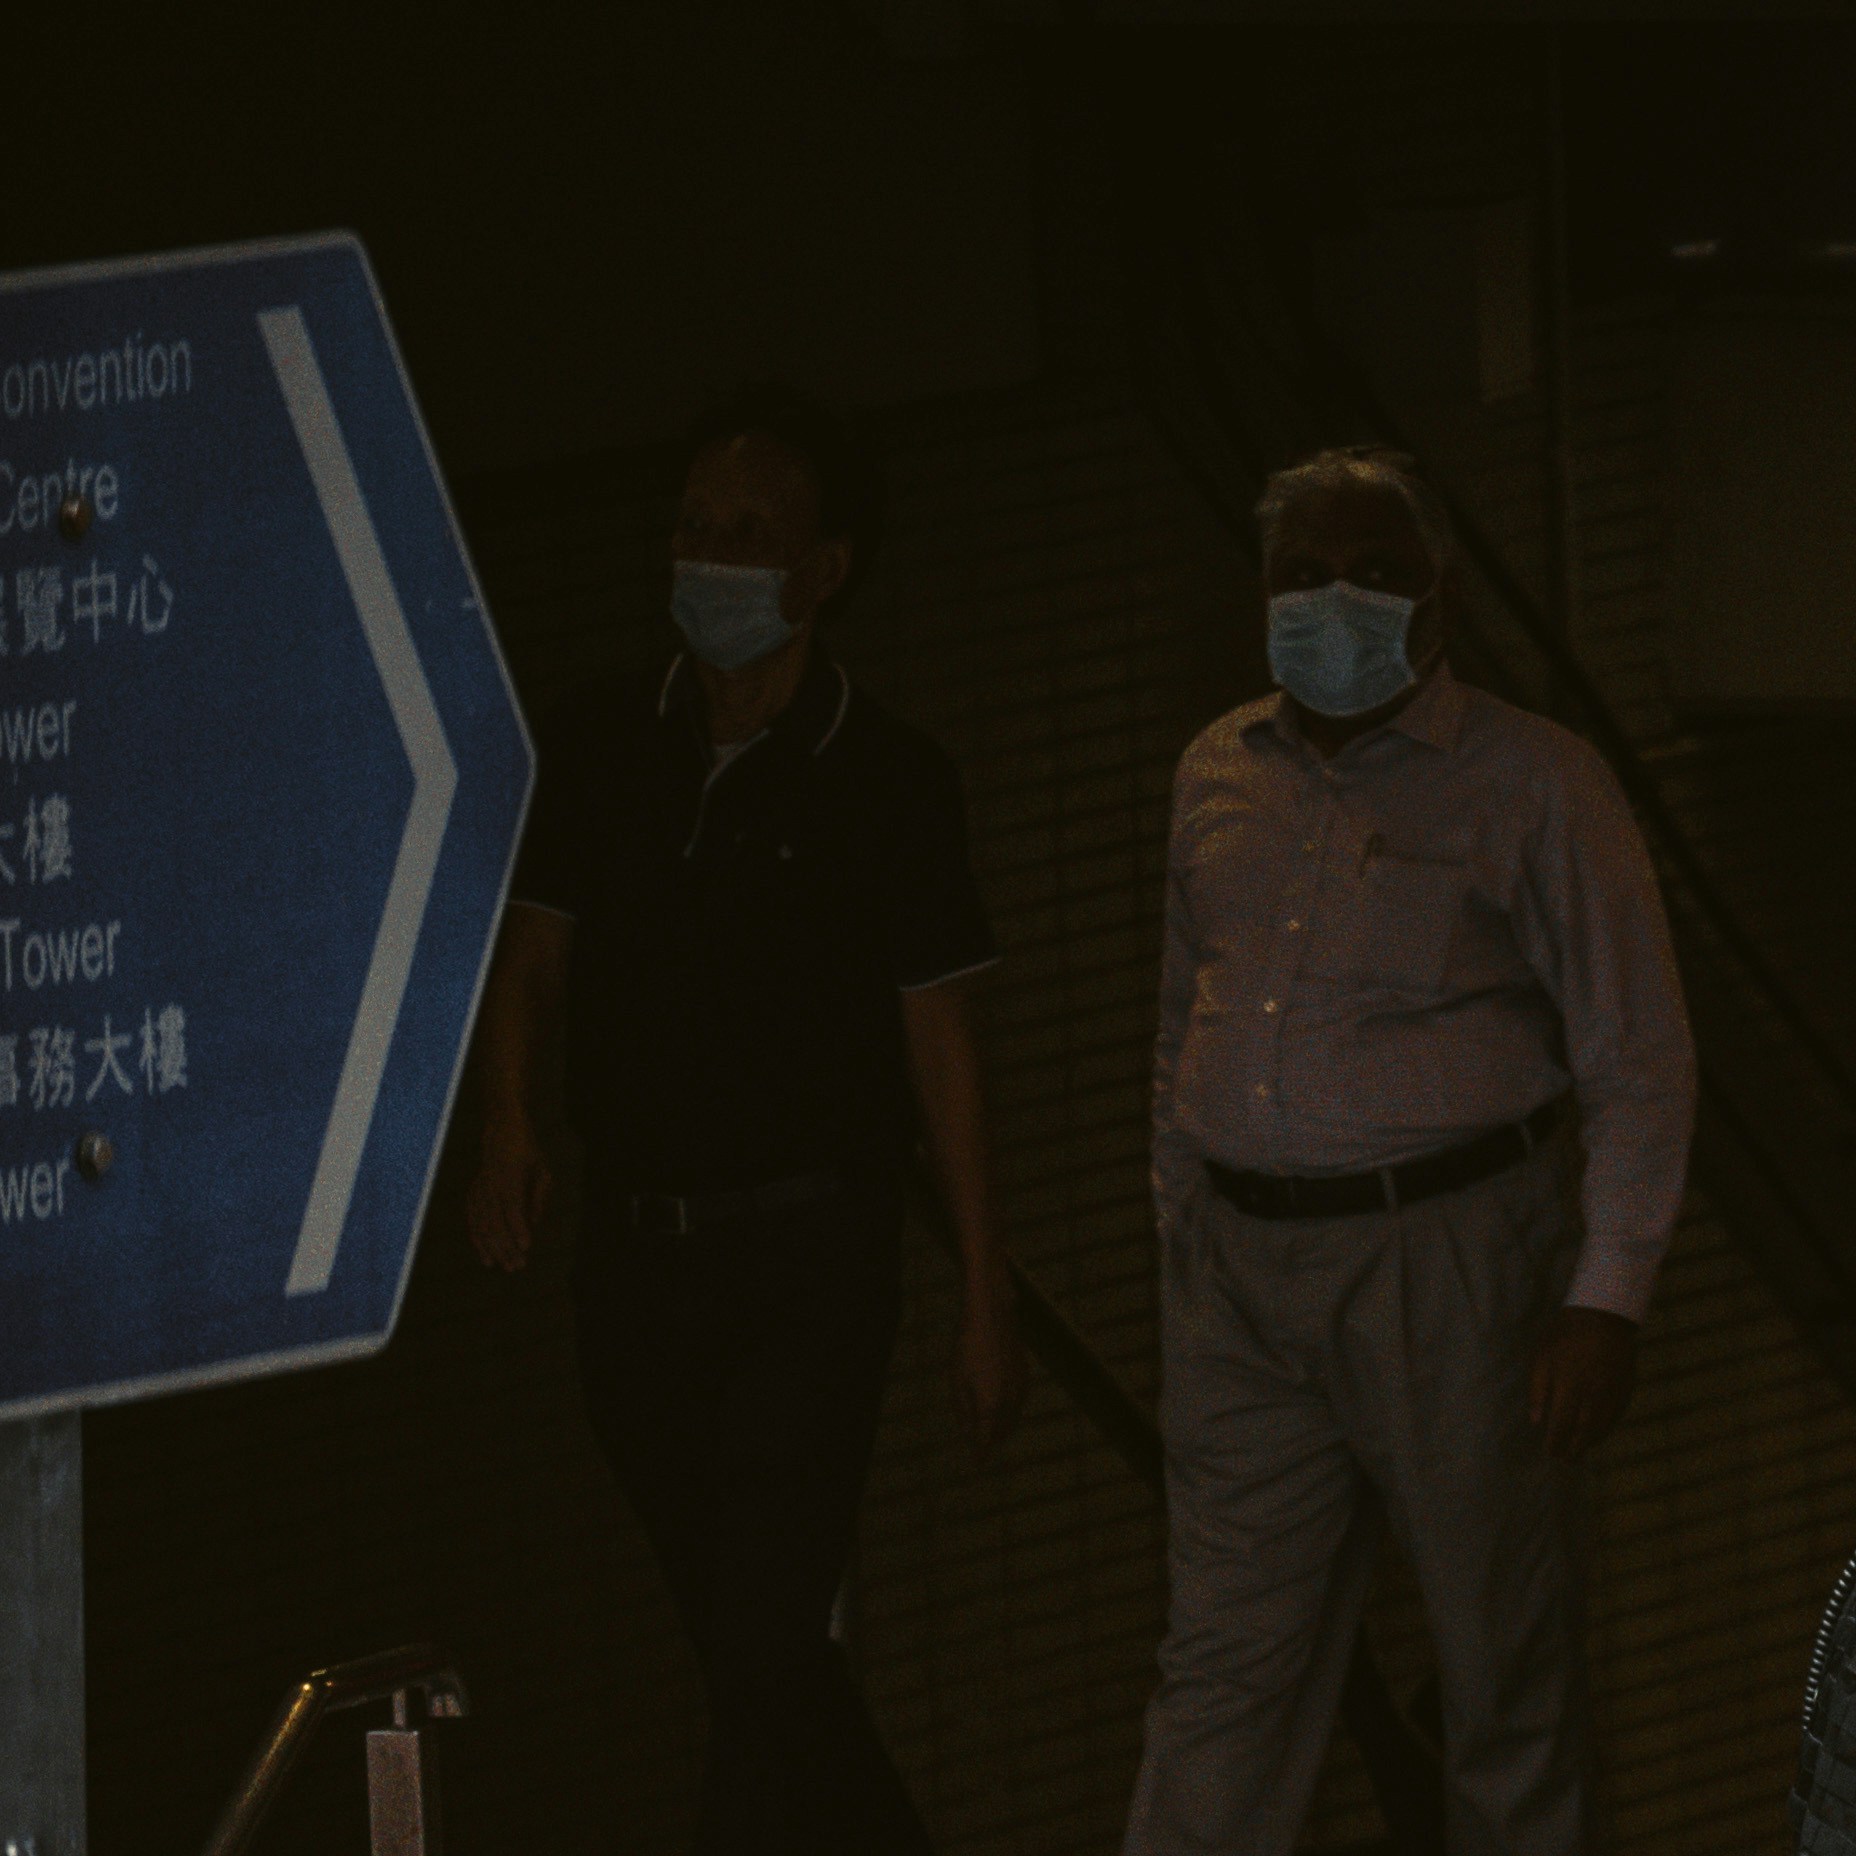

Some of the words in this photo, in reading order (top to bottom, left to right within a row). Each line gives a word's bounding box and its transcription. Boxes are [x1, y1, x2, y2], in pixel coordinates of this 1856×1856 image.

[3, 329, 193, 418] onvention
[0, 553, 174, 657] 覽中心
[0, 917, 121, 992] Tower
